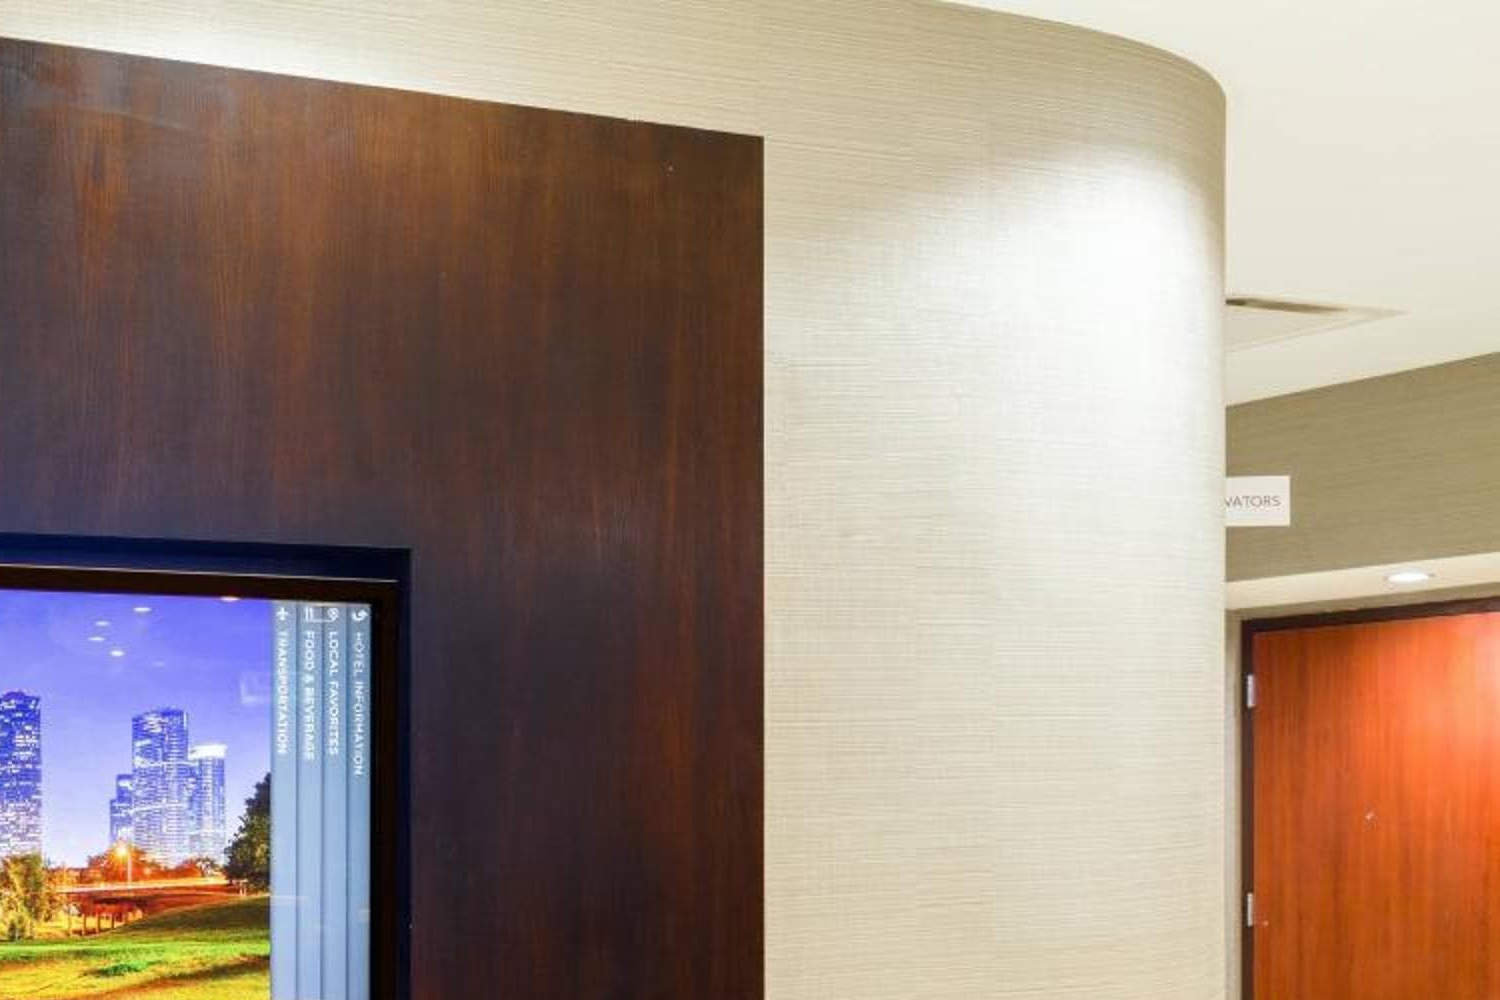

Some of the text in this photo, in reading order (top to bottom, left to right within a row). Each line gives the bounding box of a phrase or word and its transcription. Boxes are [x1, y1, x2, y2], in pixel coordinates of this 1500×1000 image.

[277, 631, 288, 755] TRANSPORTATION
[304, 629, 315, 671] FOOD
[329, 631, 339, 756] LOCAL FAVORITES
[353, 632, 364, 776] HOTEL INFORMATION
[304, 687, 315, 761] BEVERAGE
